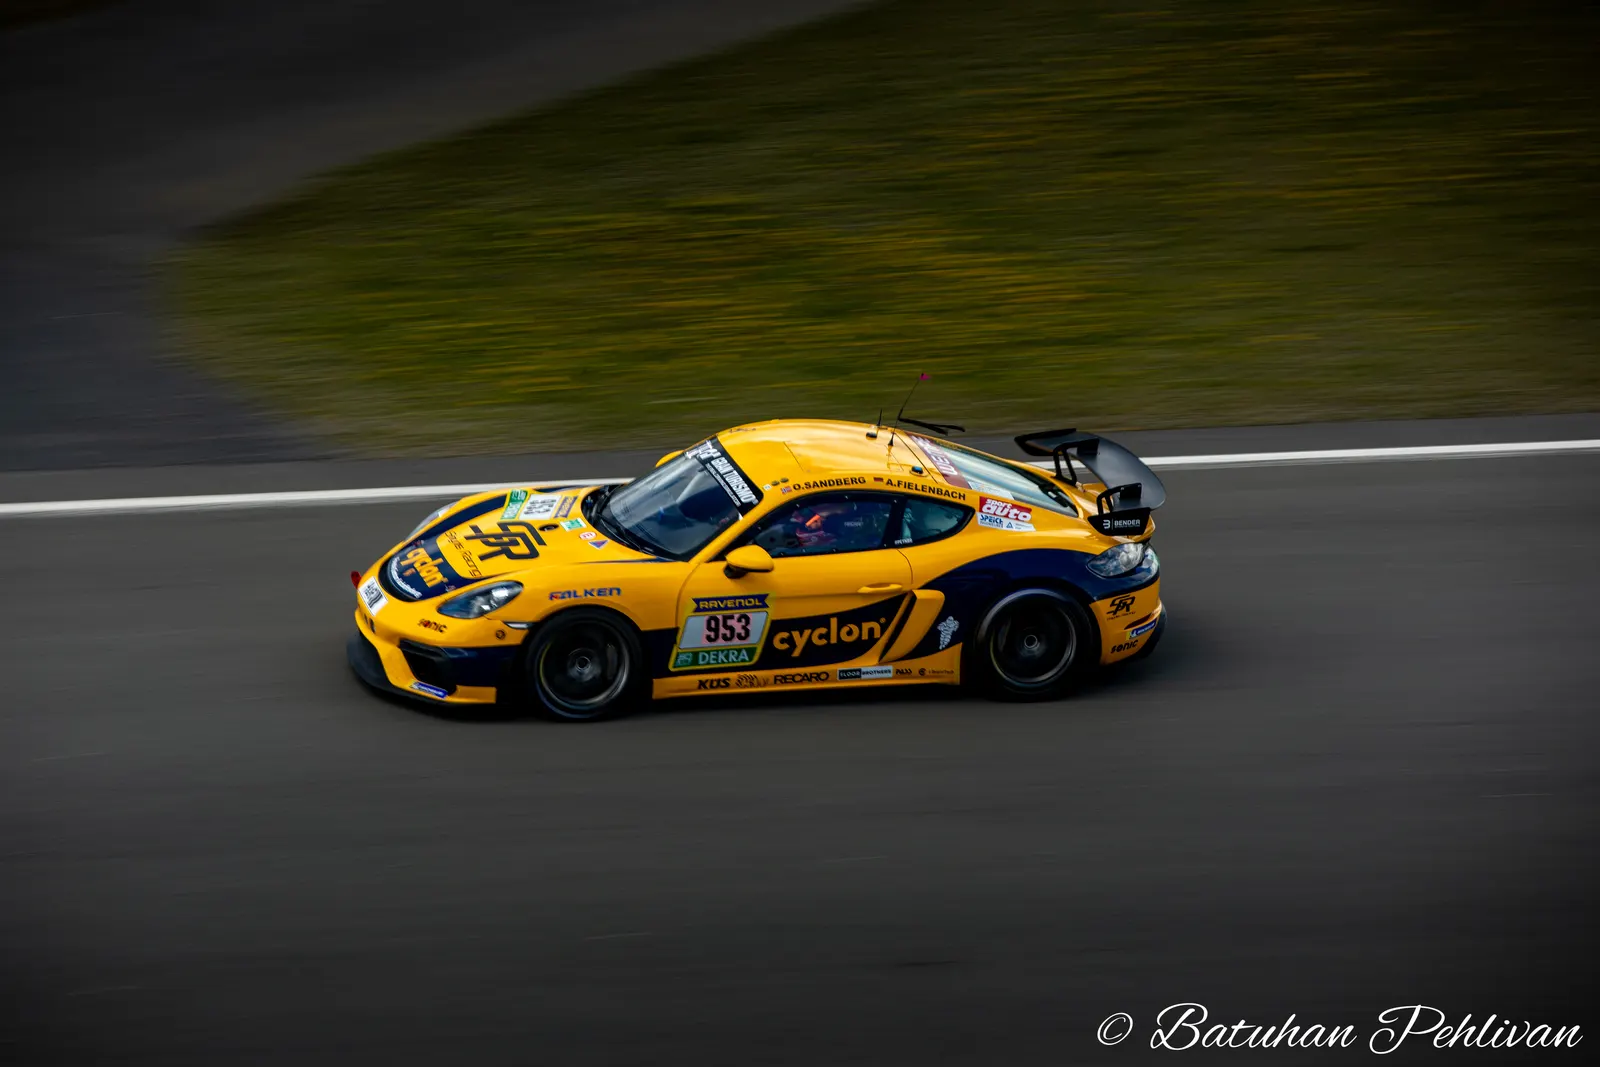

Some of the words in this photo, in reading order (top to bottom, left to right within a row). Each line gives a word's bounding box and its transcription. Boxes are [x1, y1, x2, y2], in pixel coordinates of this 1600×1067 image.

[792, 476, 867, 491] O.SANDBERG
[886, 478, 967, 501] A.FIELENBACH
[982, 503, 1032, 522] auto
[549, 587, 622, 601] FALKEN
[699, 598, 763, 609] RAVENOL
[705, 613, 751, 643] 953
[698, 648, 750, 665] DEKRA
[773, 671, 830, 685] RECARO
